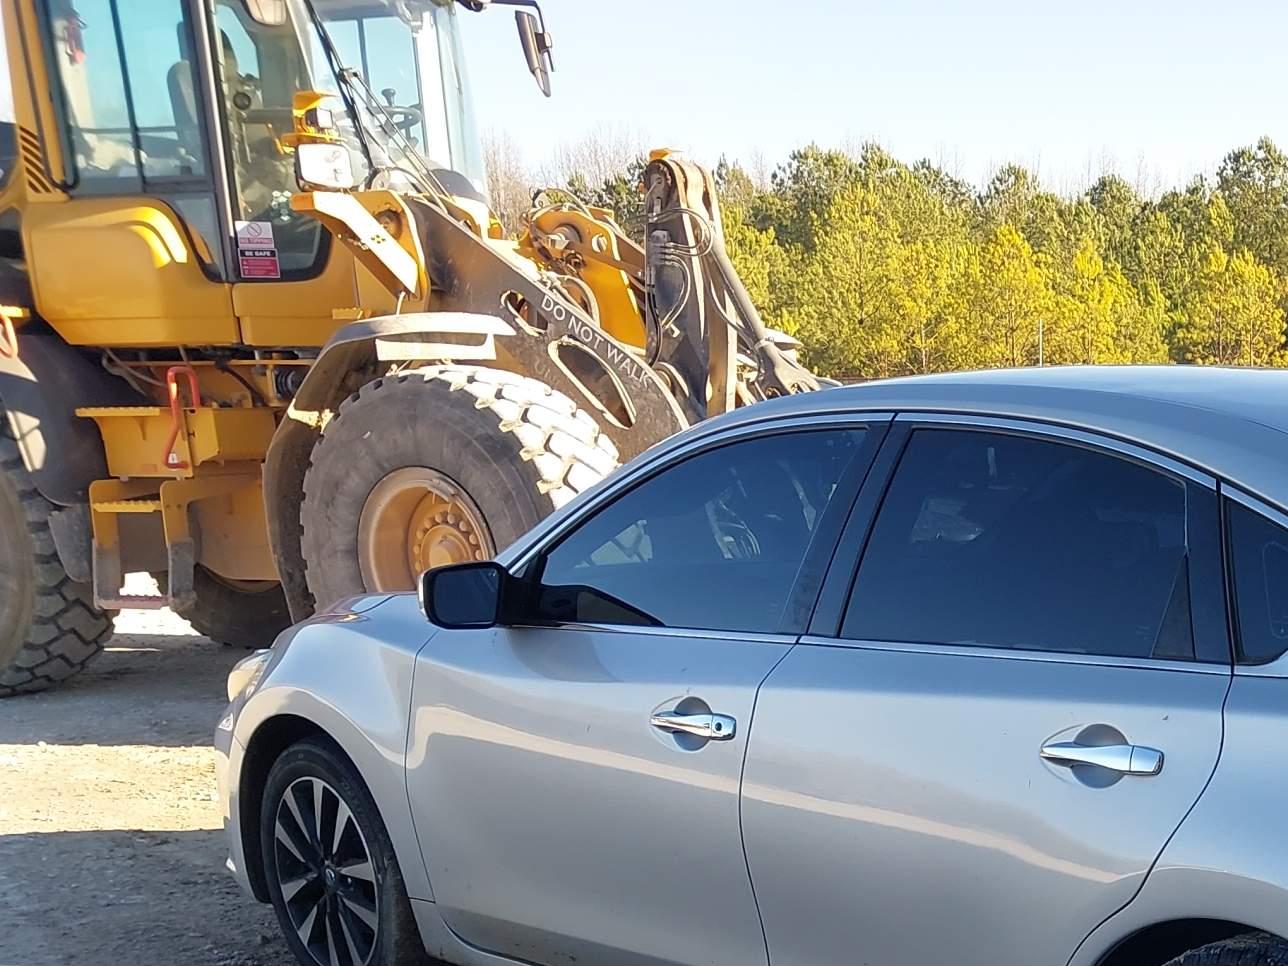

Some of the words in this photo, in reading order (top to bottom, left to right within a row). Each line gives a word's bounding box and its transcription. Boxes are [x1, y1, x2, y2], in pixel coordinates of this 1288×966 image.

[541, 295, 566, 321] DO
[568, 316, 605, 349] NOT
[607, 343, 652, 388] WALK
